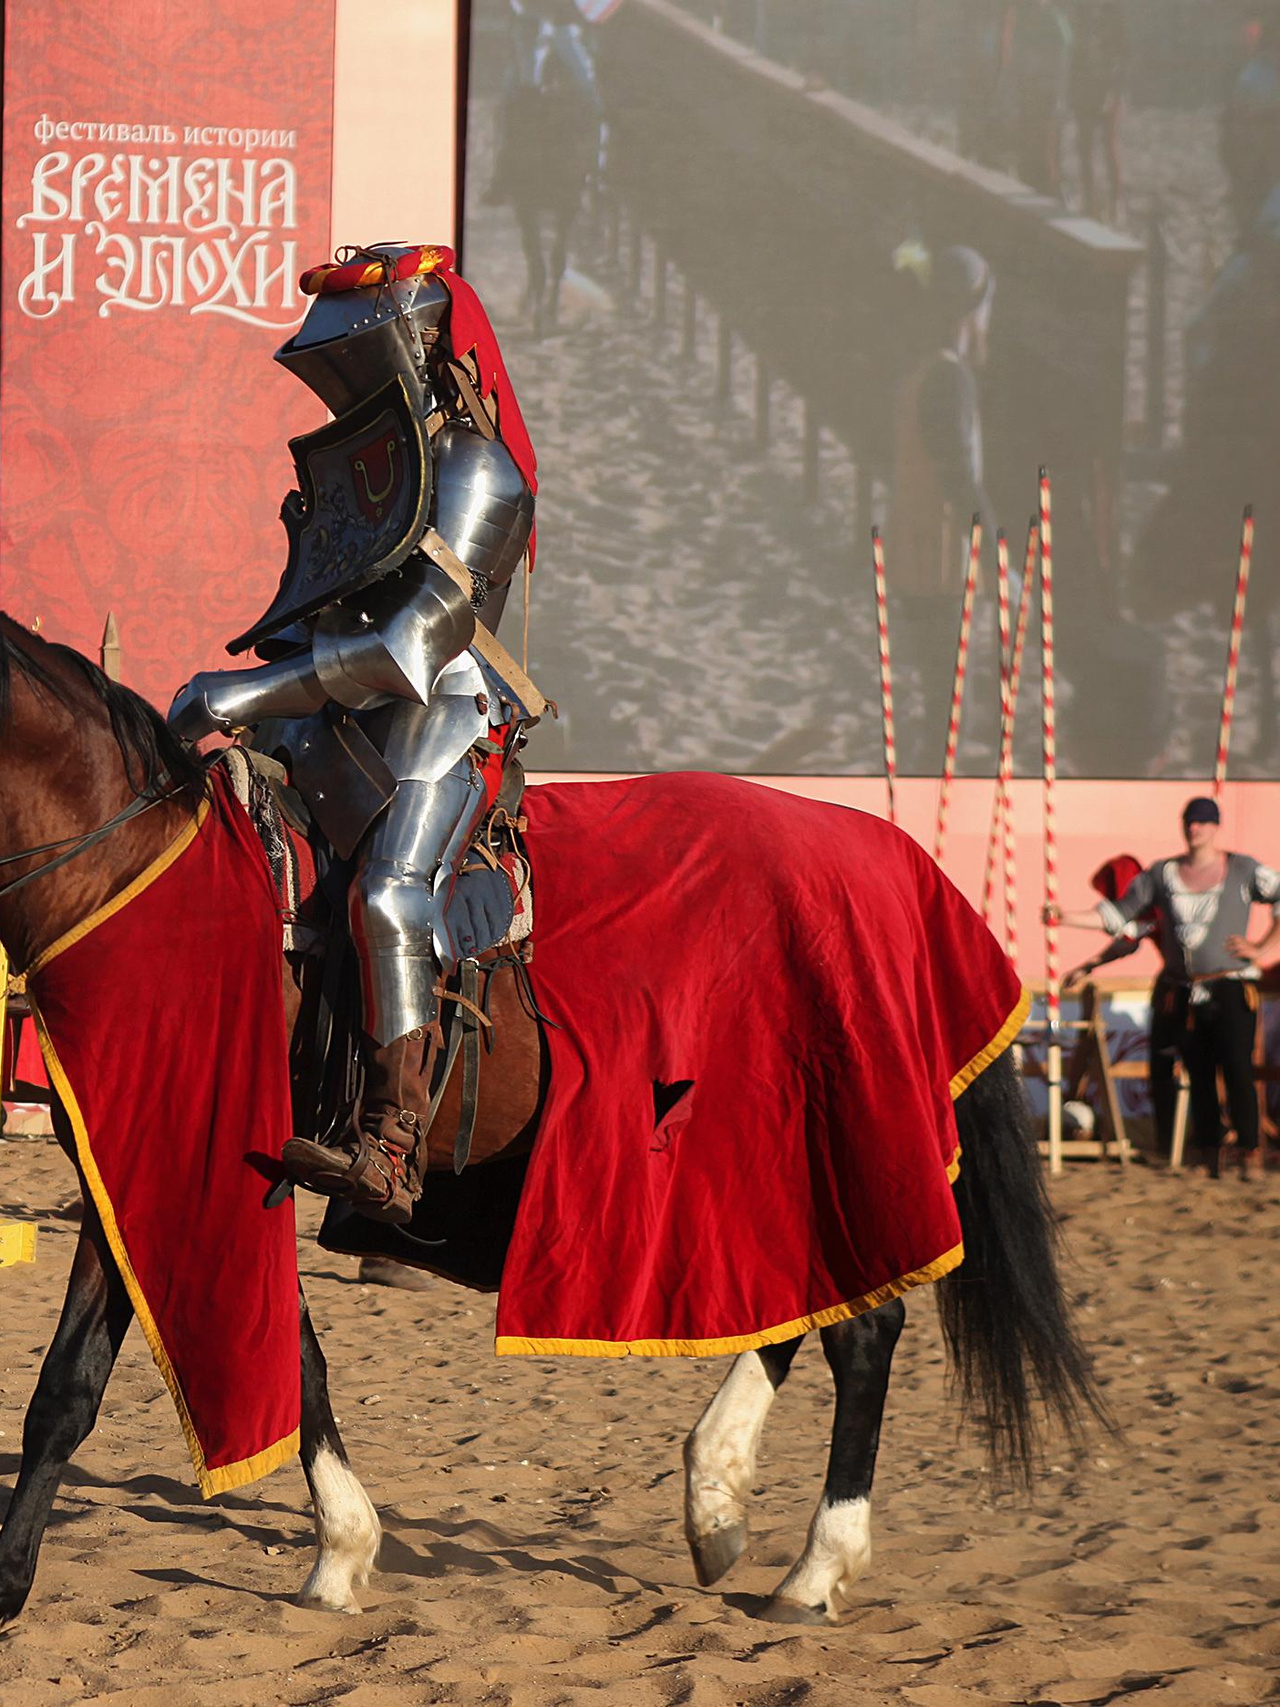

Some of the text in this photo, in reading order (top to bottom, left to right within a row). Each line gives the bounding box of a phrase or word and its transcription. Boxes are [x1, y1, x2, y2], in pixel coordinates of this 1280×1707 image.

[34, 114, 297, 152] фестиваль истории
[16, 152, 297, 241] ВРЕМЕНА
[18, 221, 312, 328] И ЭПОХИ
